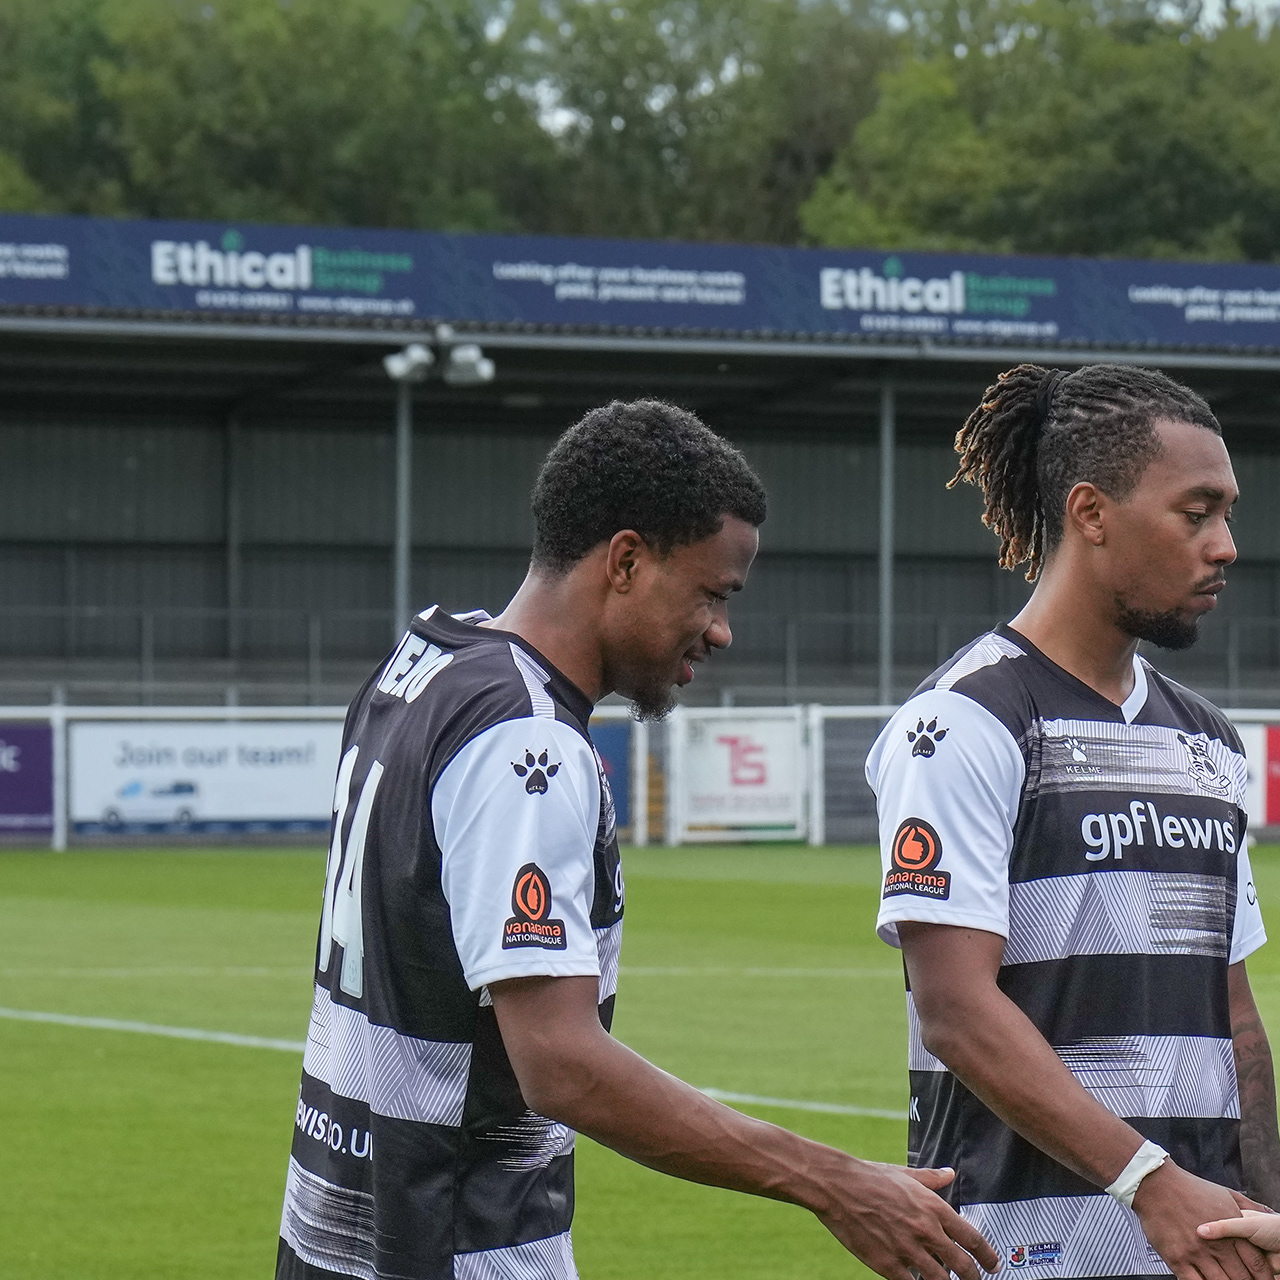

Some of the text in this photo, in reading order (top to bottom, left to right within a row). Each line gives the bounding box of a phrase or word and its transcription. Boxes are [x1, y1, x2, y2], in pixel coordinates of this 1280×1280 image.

[151, 230, 312, 290] Ethical
[819, 257, 966, 313] Ethical
[114, 738, 173, 769] Join
[181, 743, 233, 769] our
[1066, 766, 1102, 775] KELME
[1081, 800, 1236, 861] gpflewis
[915, 884, 945, 896] LEAGUE
[506, 922, 562, 937] vanarama
